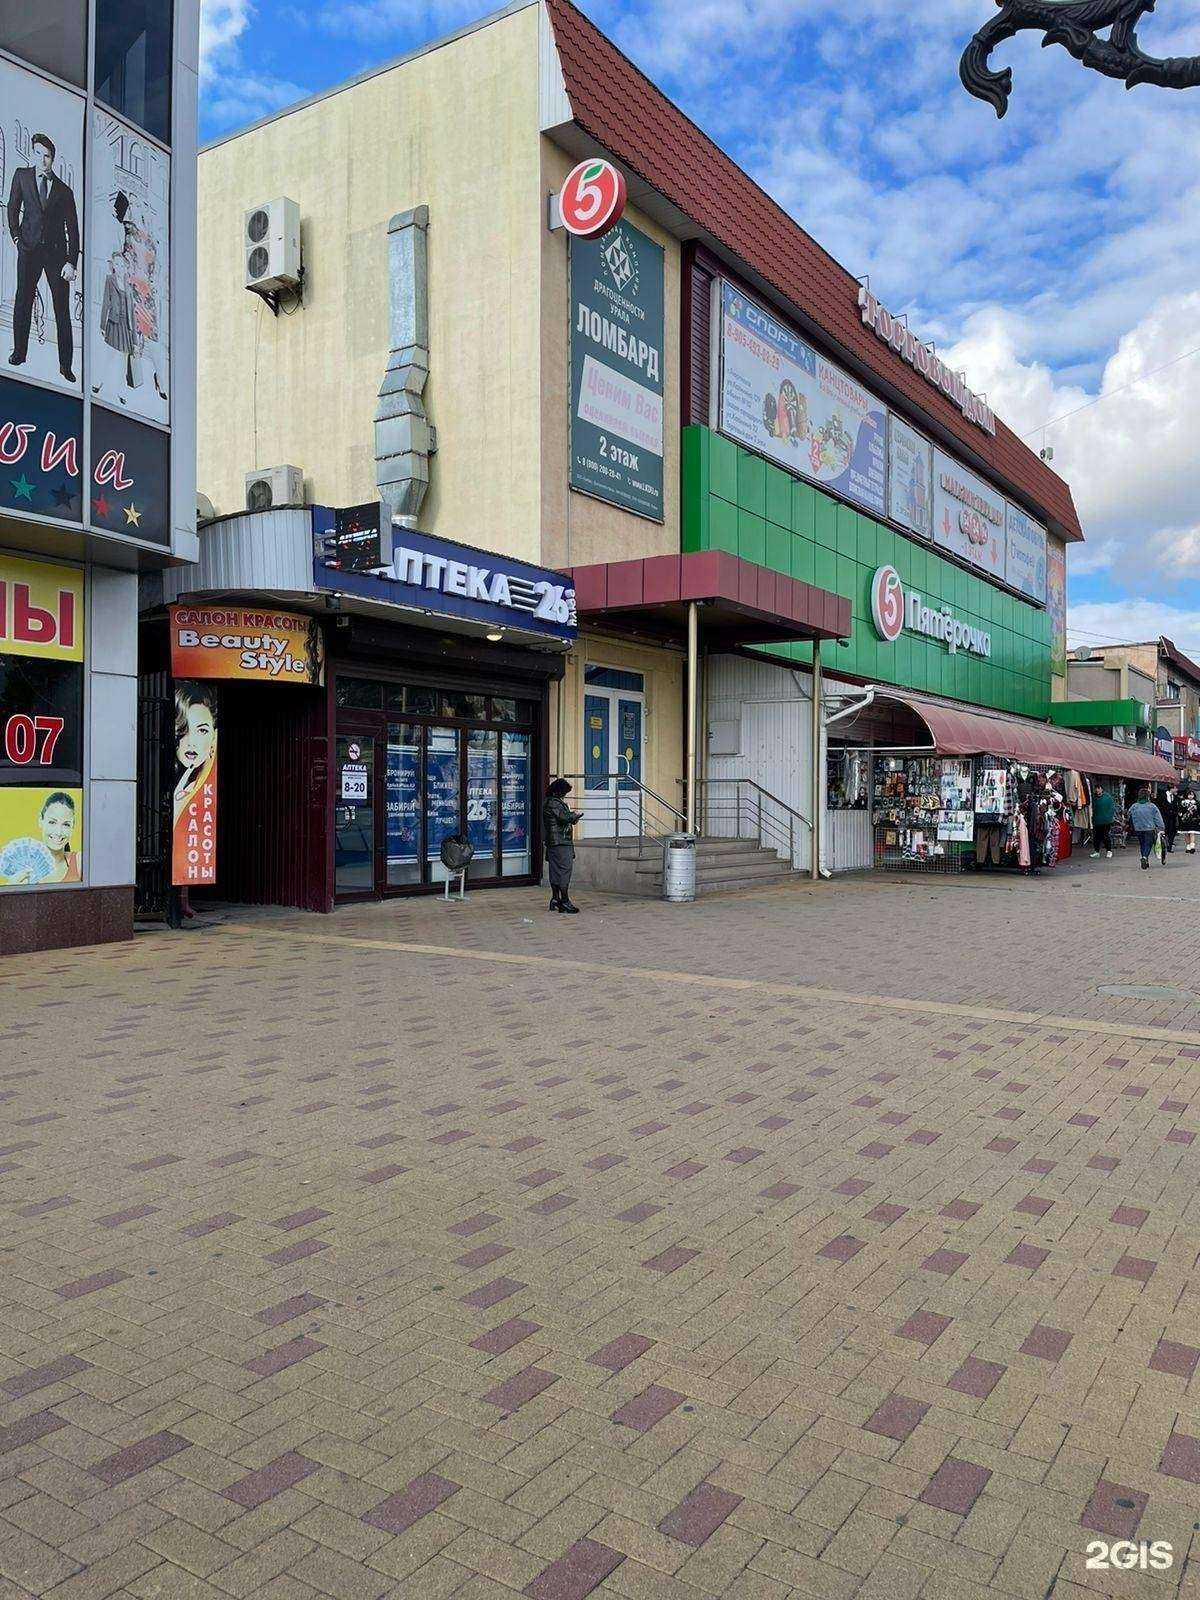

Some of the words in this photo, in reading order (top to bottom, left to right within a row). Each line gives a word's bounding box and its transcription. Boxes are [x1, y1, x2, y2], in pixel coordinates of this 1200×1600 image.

[593, 279, 645, 321] ДРАГОЦЕННОСТИ
[610, 303, 631, 324] УРАЛА
[576, 302, 660, 383] ЛОМБАРД
[746, 306, 799, 353] СПОРТ
[599, 435, 608, 458] 2
[610, 445, 639, 472] этаж
[533, 581, 569, 624] 26
[176, 610, 239, 627] САЛОН
[242, 610, 309, 633] КРАСОТЫ
[904, 590, 991, 657] Пятёрочка
[178, 629, 289, 656] Beauty
[239, 651, 306, 676] Style
[342, 763, 368, 772] АПТЕКА
[344, 782, 366, 793] 8-20
[468, 787, 492, 796] ПТЕКА
[467, 799, 487, 822] 26
[187, 802, 198, 879] САЛОН
[201, 783, 214, 877] КРАСОТЫ
